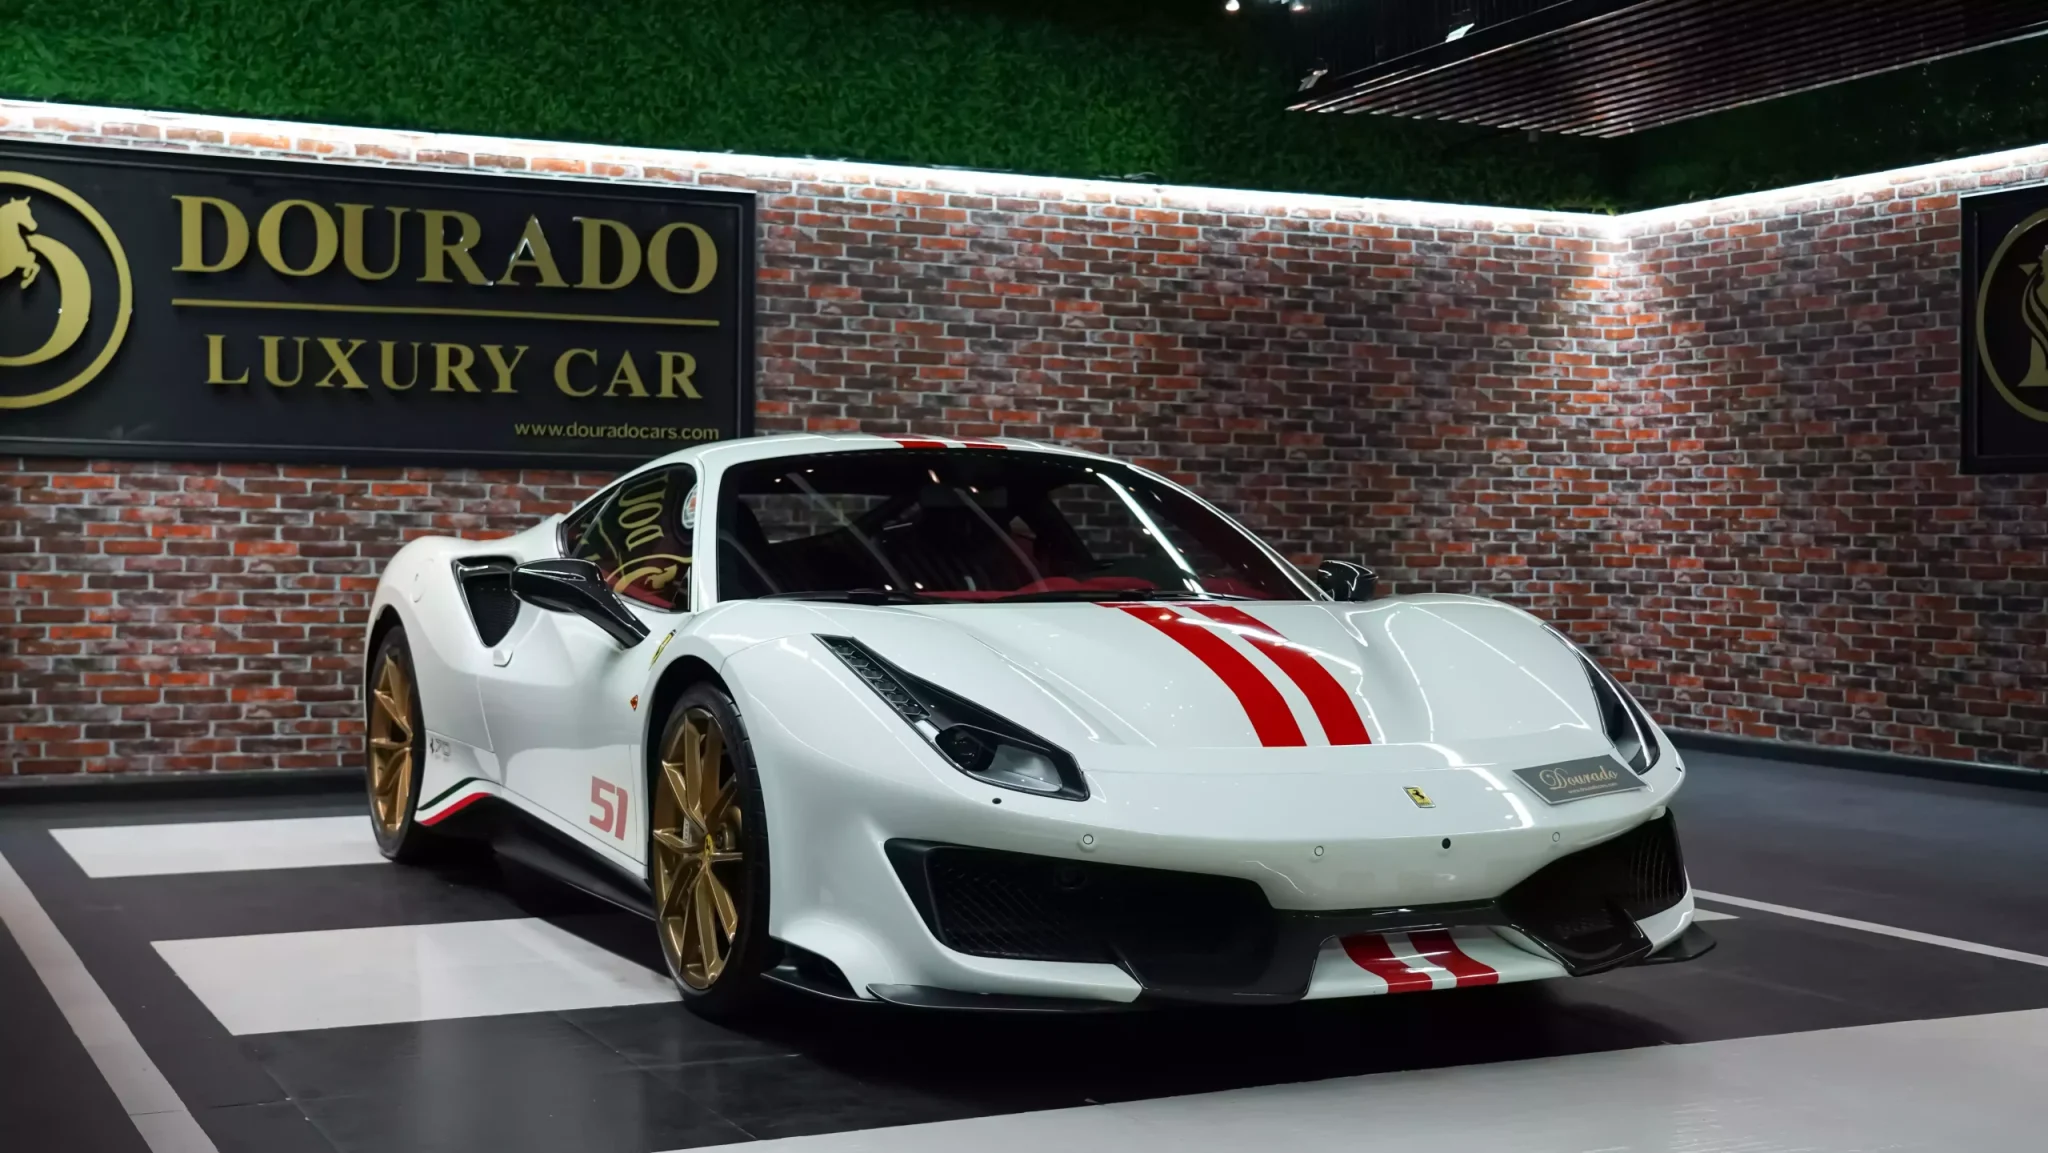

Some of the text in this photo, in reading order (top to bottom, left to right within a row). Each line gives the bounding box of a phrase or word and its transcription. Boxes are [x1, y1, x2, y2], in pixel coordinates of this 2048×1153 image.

[171, 194, 719, 294] DOURADO
[204, 333, 704, 399] LUXURY CAR
[514, 421, 720, 441] www.douradocars.com
[589, 775, 629, 841] 51
[1539, 765, 1619, 790] Dourado
